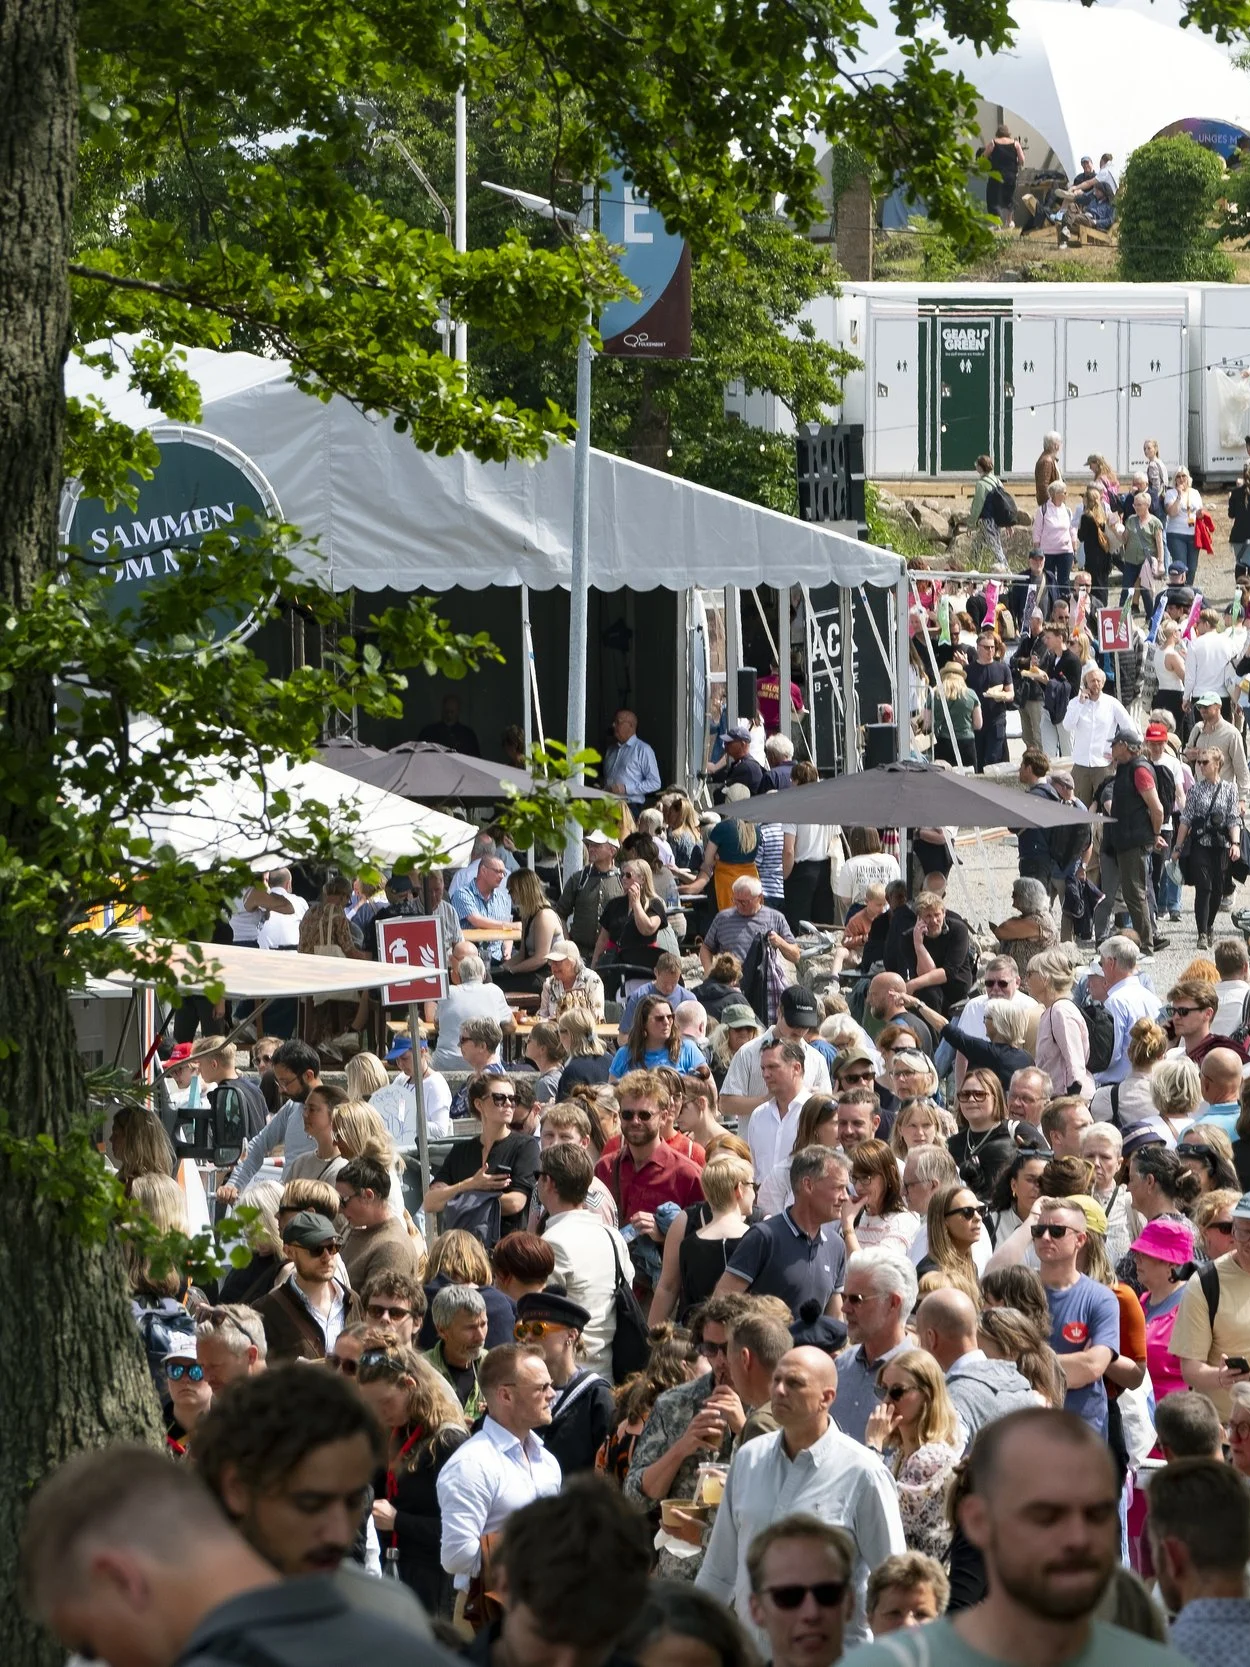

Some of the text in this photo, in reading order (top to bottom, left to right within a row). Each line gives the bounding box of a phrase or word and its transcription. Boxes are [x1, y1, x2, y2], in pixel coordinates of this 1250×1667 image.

[623, 186, 654, 243] E
[944, 339, 985, 351] GREEN
[91, 502, 236, 554] SAMMEN
